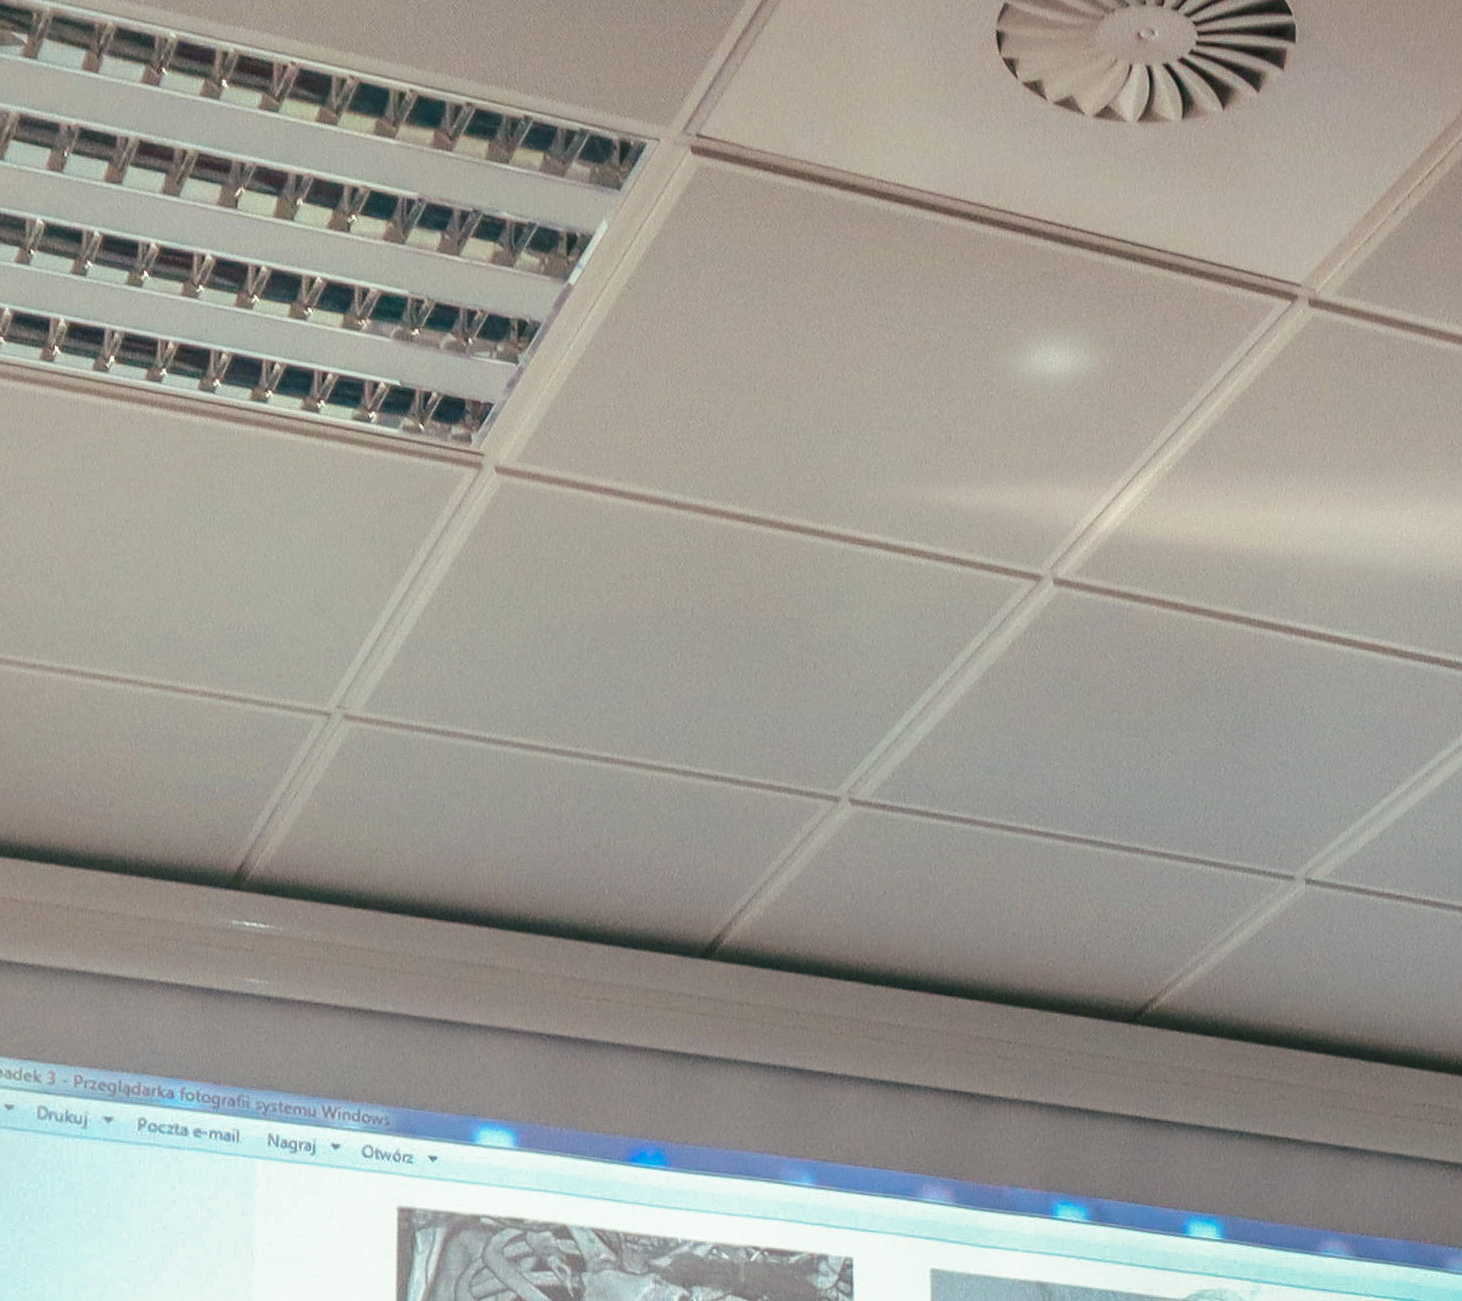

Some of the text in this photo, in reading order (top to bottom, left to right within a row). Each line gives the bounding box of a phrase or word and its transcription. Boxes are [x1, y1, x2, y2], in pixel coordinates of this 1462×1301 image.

[46, 1070, 56, 1086] 3
[72, 1074, 175, 1099] Przeglądarka
[179, 1087, 251, 1110] fotografii
[255, 1099, 317, 1117] systemu
[321, 1105, 391, 1126] Windows
[37, 1105, 89, 1128] Drukuj
[137, 1117, 241, 1143] Poczta e-mail
[267, 1133, 317, 1156] Nagraj
[361, 1144, 414, 1164] Otwórz
